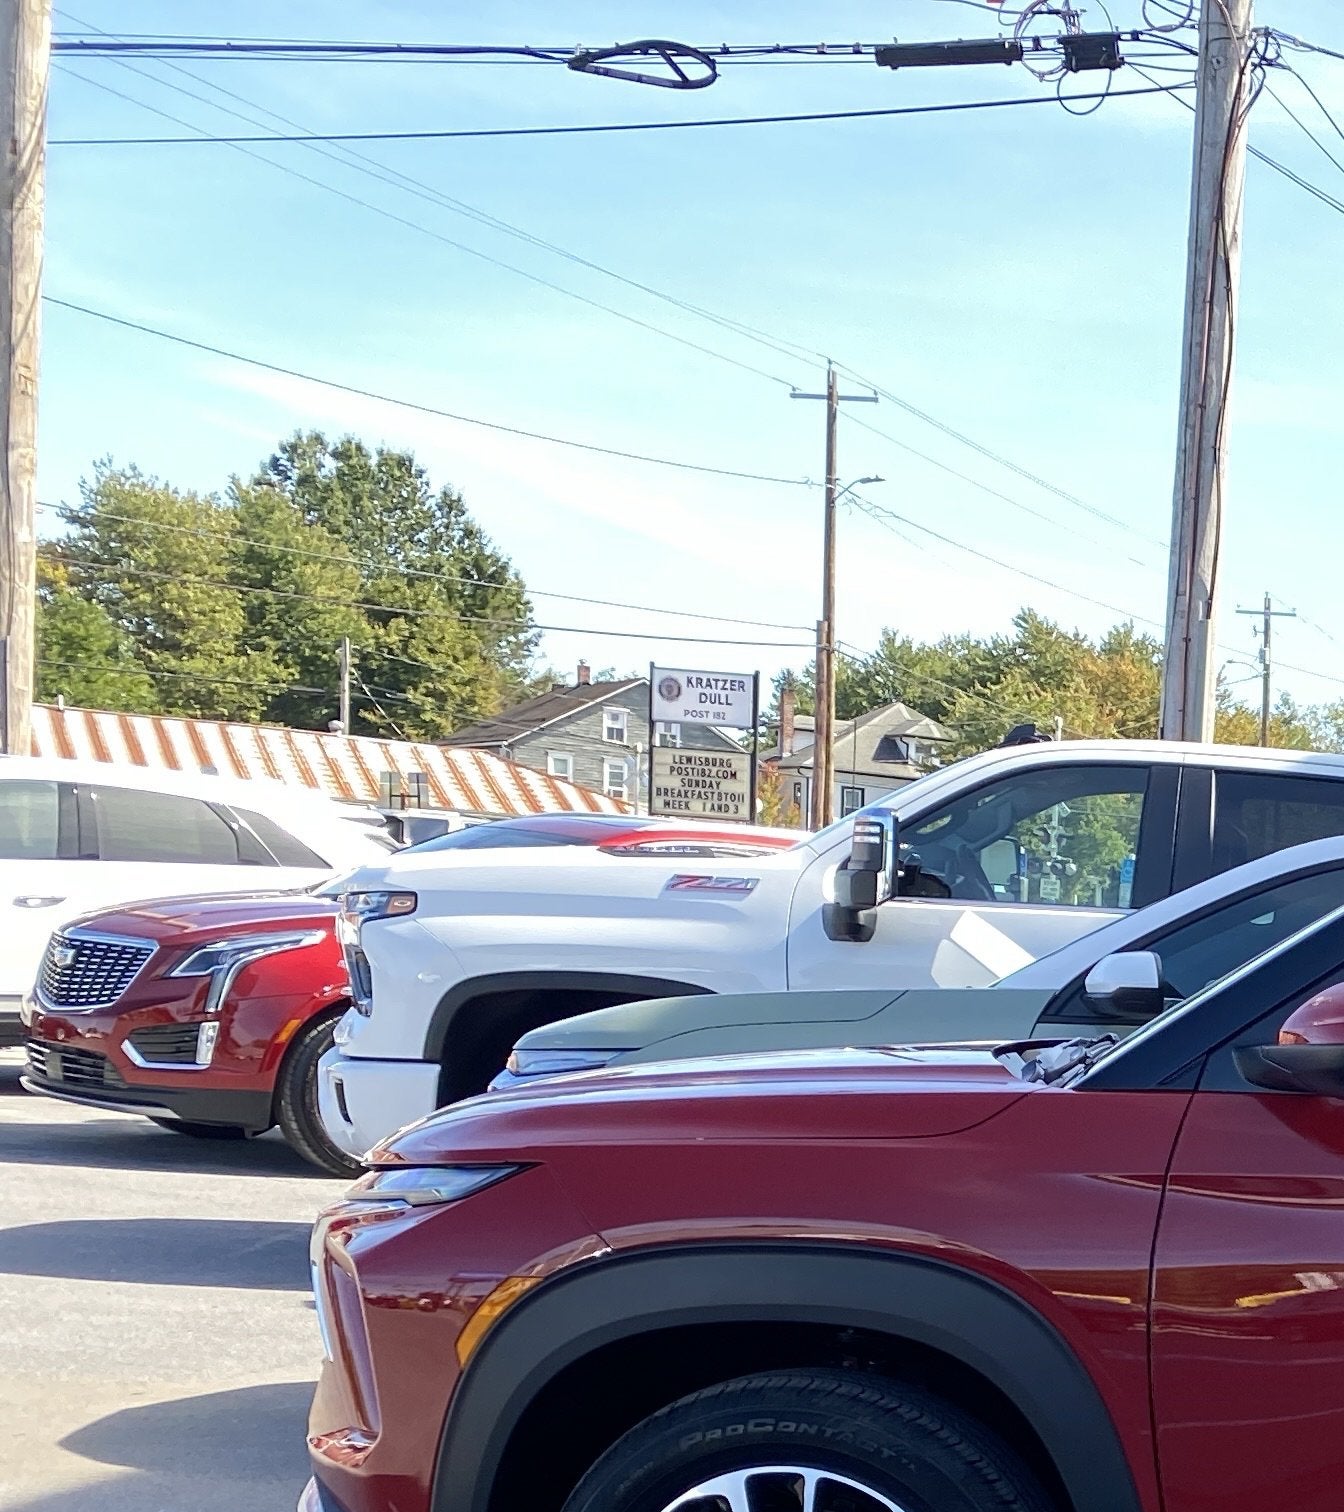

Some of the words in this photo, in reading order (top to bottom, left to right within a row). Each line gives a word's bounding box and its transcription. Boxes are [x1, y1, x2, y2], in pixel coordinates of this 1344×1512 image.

[686, 675, 746, 693] KRATZER
[698, 692, 733, 706] DULL
[683, 709, 710, 719] POST
[712, 711, 727, 721] 182
[672, 754, 733, 768] LEWISBURG
[669, 765, 737, 780] POST182.COM
[680, 777, 722, 790] SUNDAY
[663, 799, 690, 811] WEEK
[710, 803, 730, 814] AND
[733, 804, 739, 814] 3
